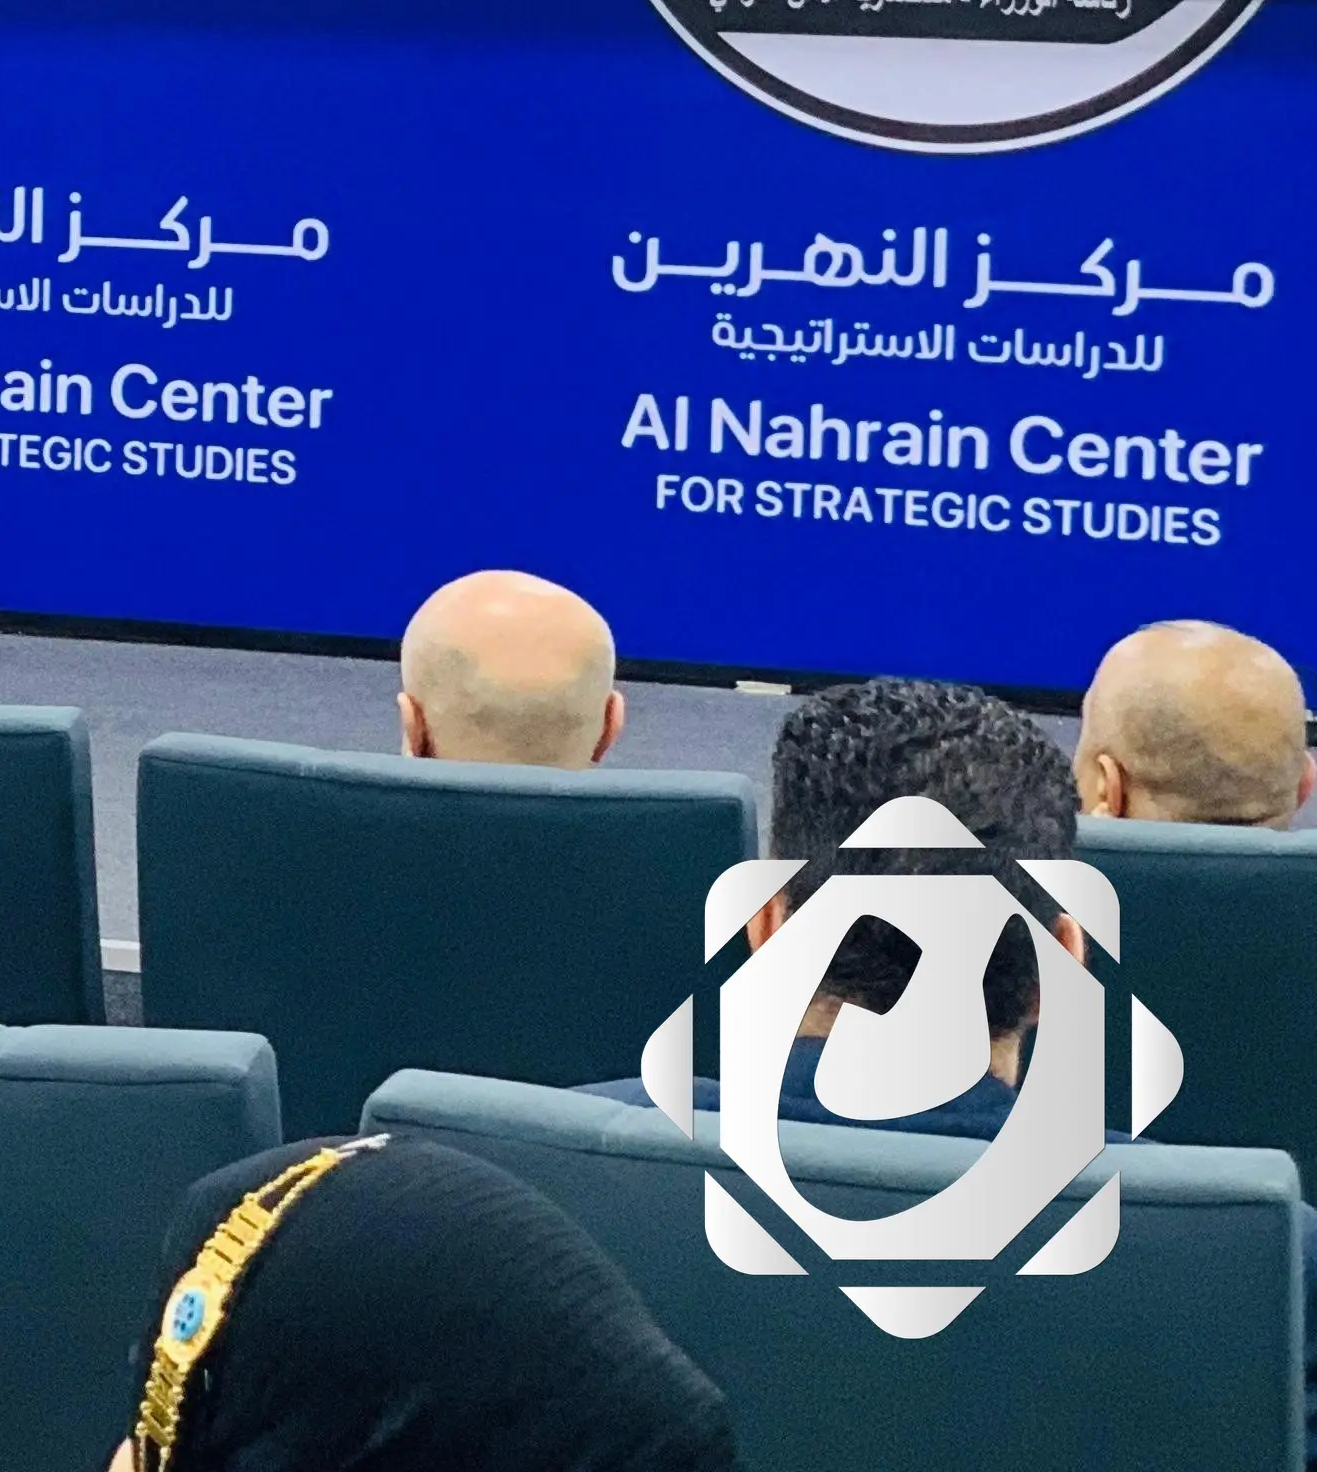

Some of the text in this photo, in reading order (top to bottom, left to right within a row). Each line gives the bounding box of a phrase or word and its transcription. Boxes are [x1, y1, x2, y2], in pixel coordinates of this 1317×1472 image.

[58, 191, 329, 269] مركز
[62, 281, 233, 329] للدراسات
[612, 226, 1275, 316] مركز النهرين
[712, 312, 1163, 379] للدراسات الاستراتيجية
[110, 363, 333, 429] Center
[122, 440, 296, 485] STUDIES
[621, 393, 1264, 486] Al Nahrain Center
[656, 474, 1221, 546] FOR STRATEGIC STUDIES
